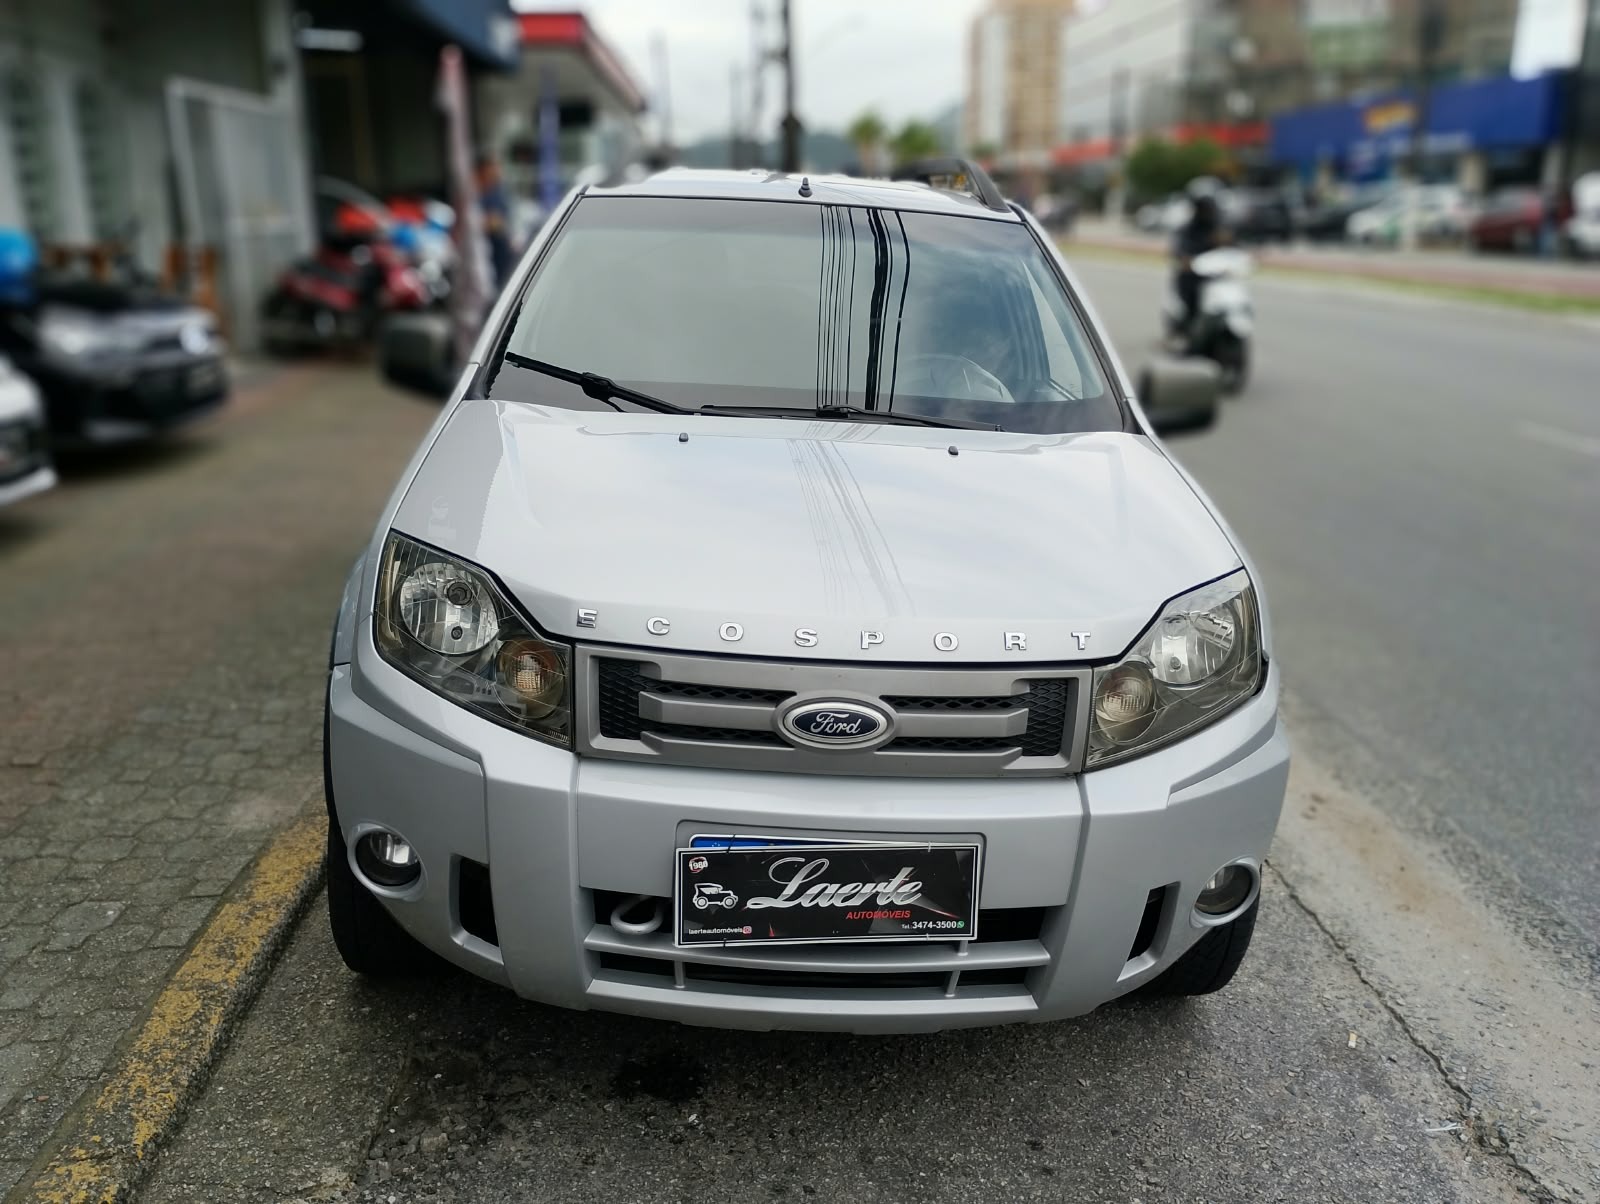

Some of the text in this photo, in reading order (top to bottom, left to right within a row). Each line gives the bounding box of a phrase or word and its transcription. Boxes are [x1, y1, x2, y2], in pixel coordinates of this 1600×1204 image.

[575, 608, 1092, 651] ECOSPORT
[810, 712, 862, 734] Ford
[747, 857, 923, 909] Laerte
[846, 909, 911, 920] AUTOMÓVEIS
[912, 921, 957, 930] 3474-3500
